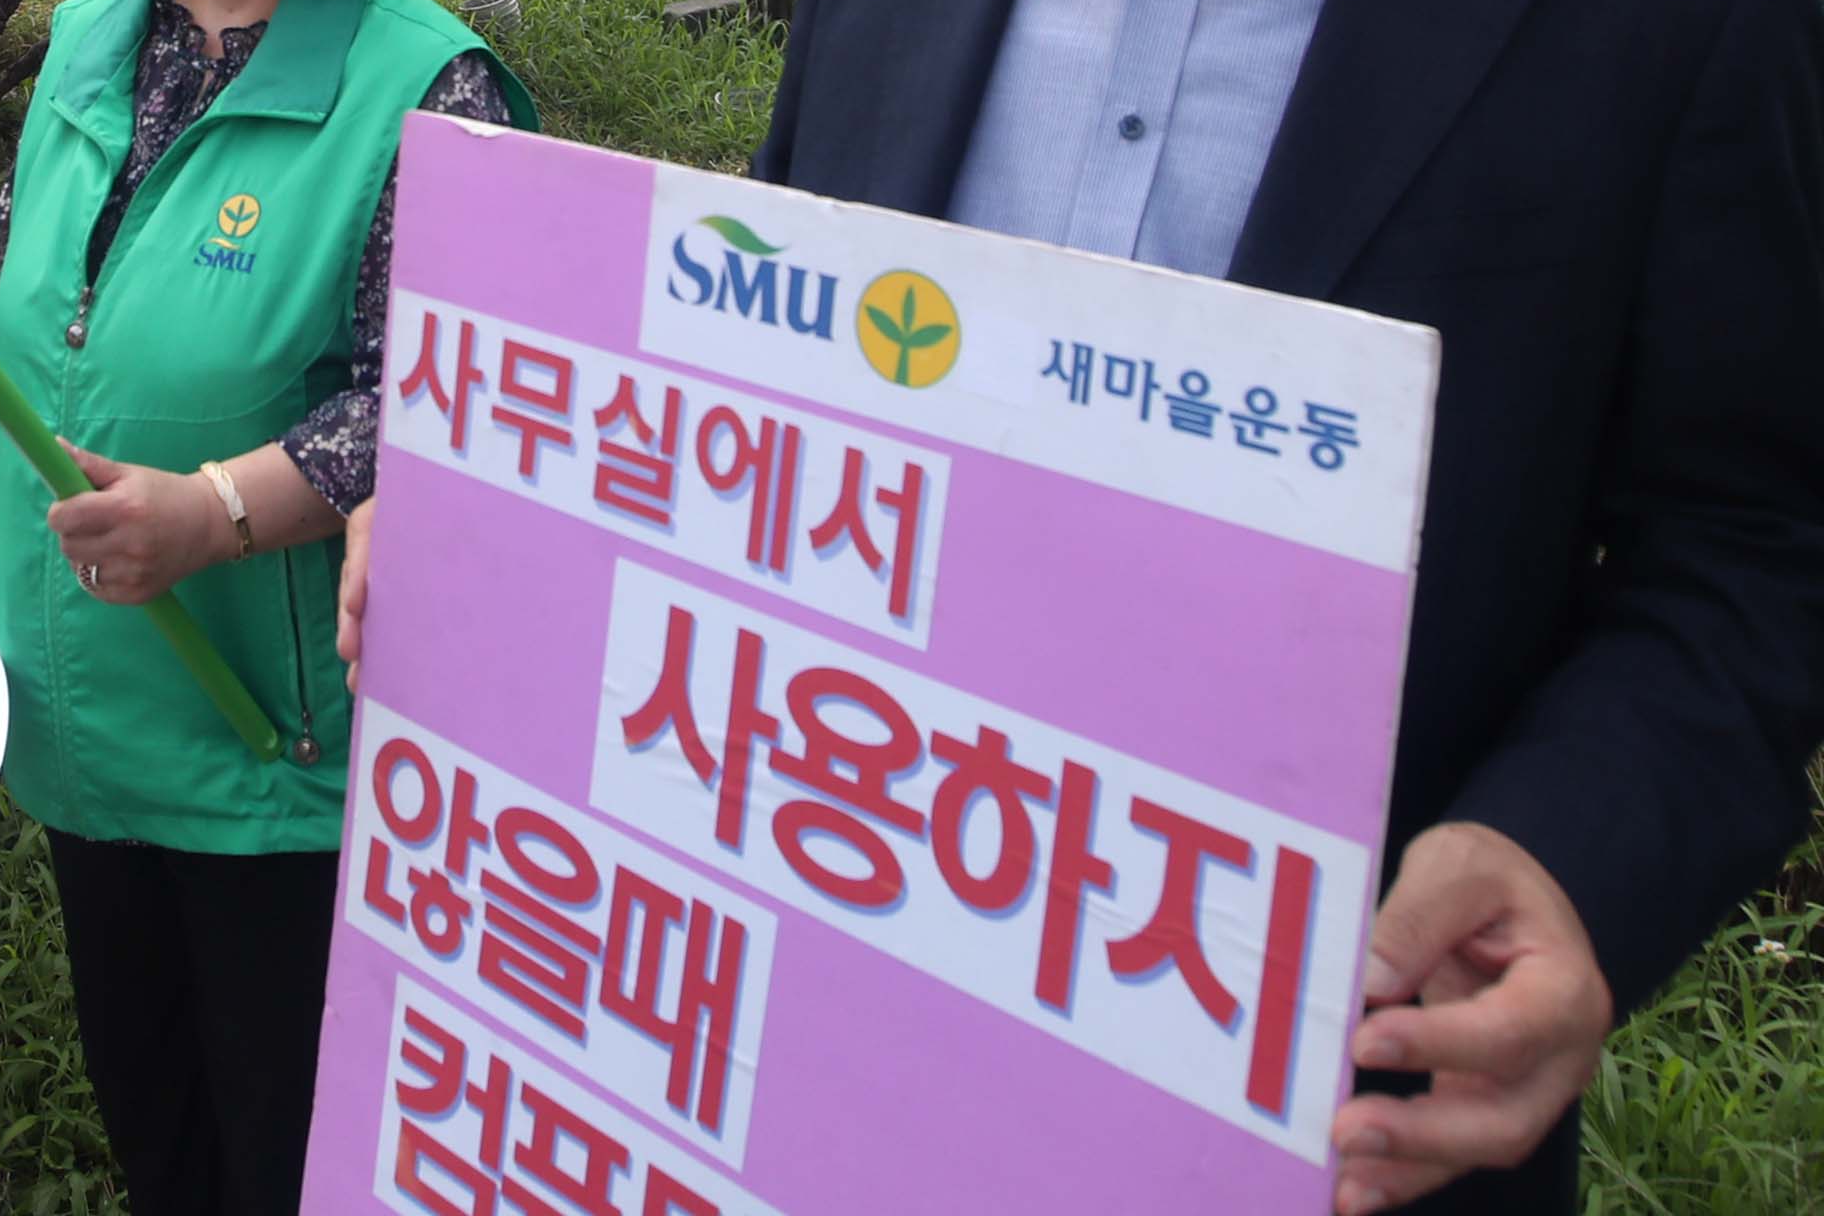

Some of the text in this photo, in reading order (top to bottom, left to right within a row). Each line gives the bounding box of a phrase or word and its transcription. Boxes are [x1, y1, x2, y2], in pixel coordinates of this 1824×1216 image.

[193, 243, 257, 275] SMU
[666, 225, 840, 344] SMU
[397, 308, 928, 622] 사무실에서
[1040, 336, 1362, 472] 새마을운동
[363, 735, 748, 1140] 않을때
[619, 601, 1322, 1120] 사용하지
